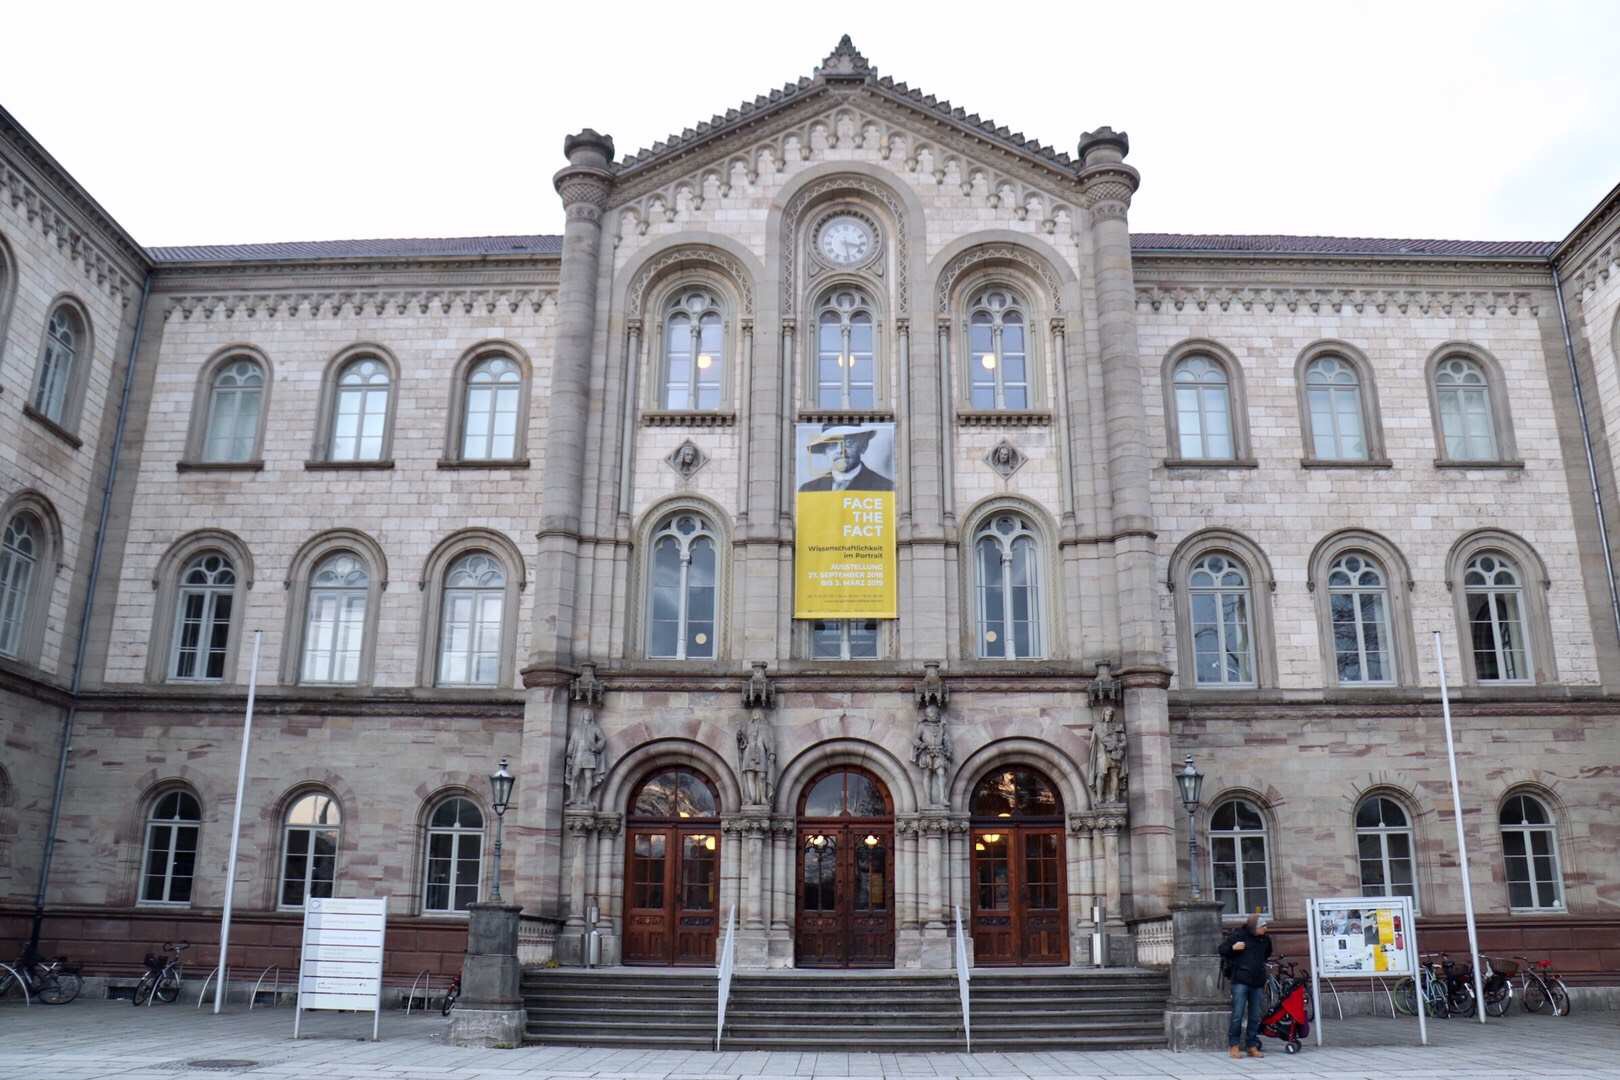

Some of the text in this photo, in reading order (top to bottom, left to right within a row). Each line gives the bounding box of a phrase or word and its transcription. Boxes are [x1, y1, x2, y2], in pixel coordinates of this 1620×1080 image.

[843, 497, 882, 509] FACE
[852, 511, 882, 523] THE
[843, 524, 882, 537] FACT
